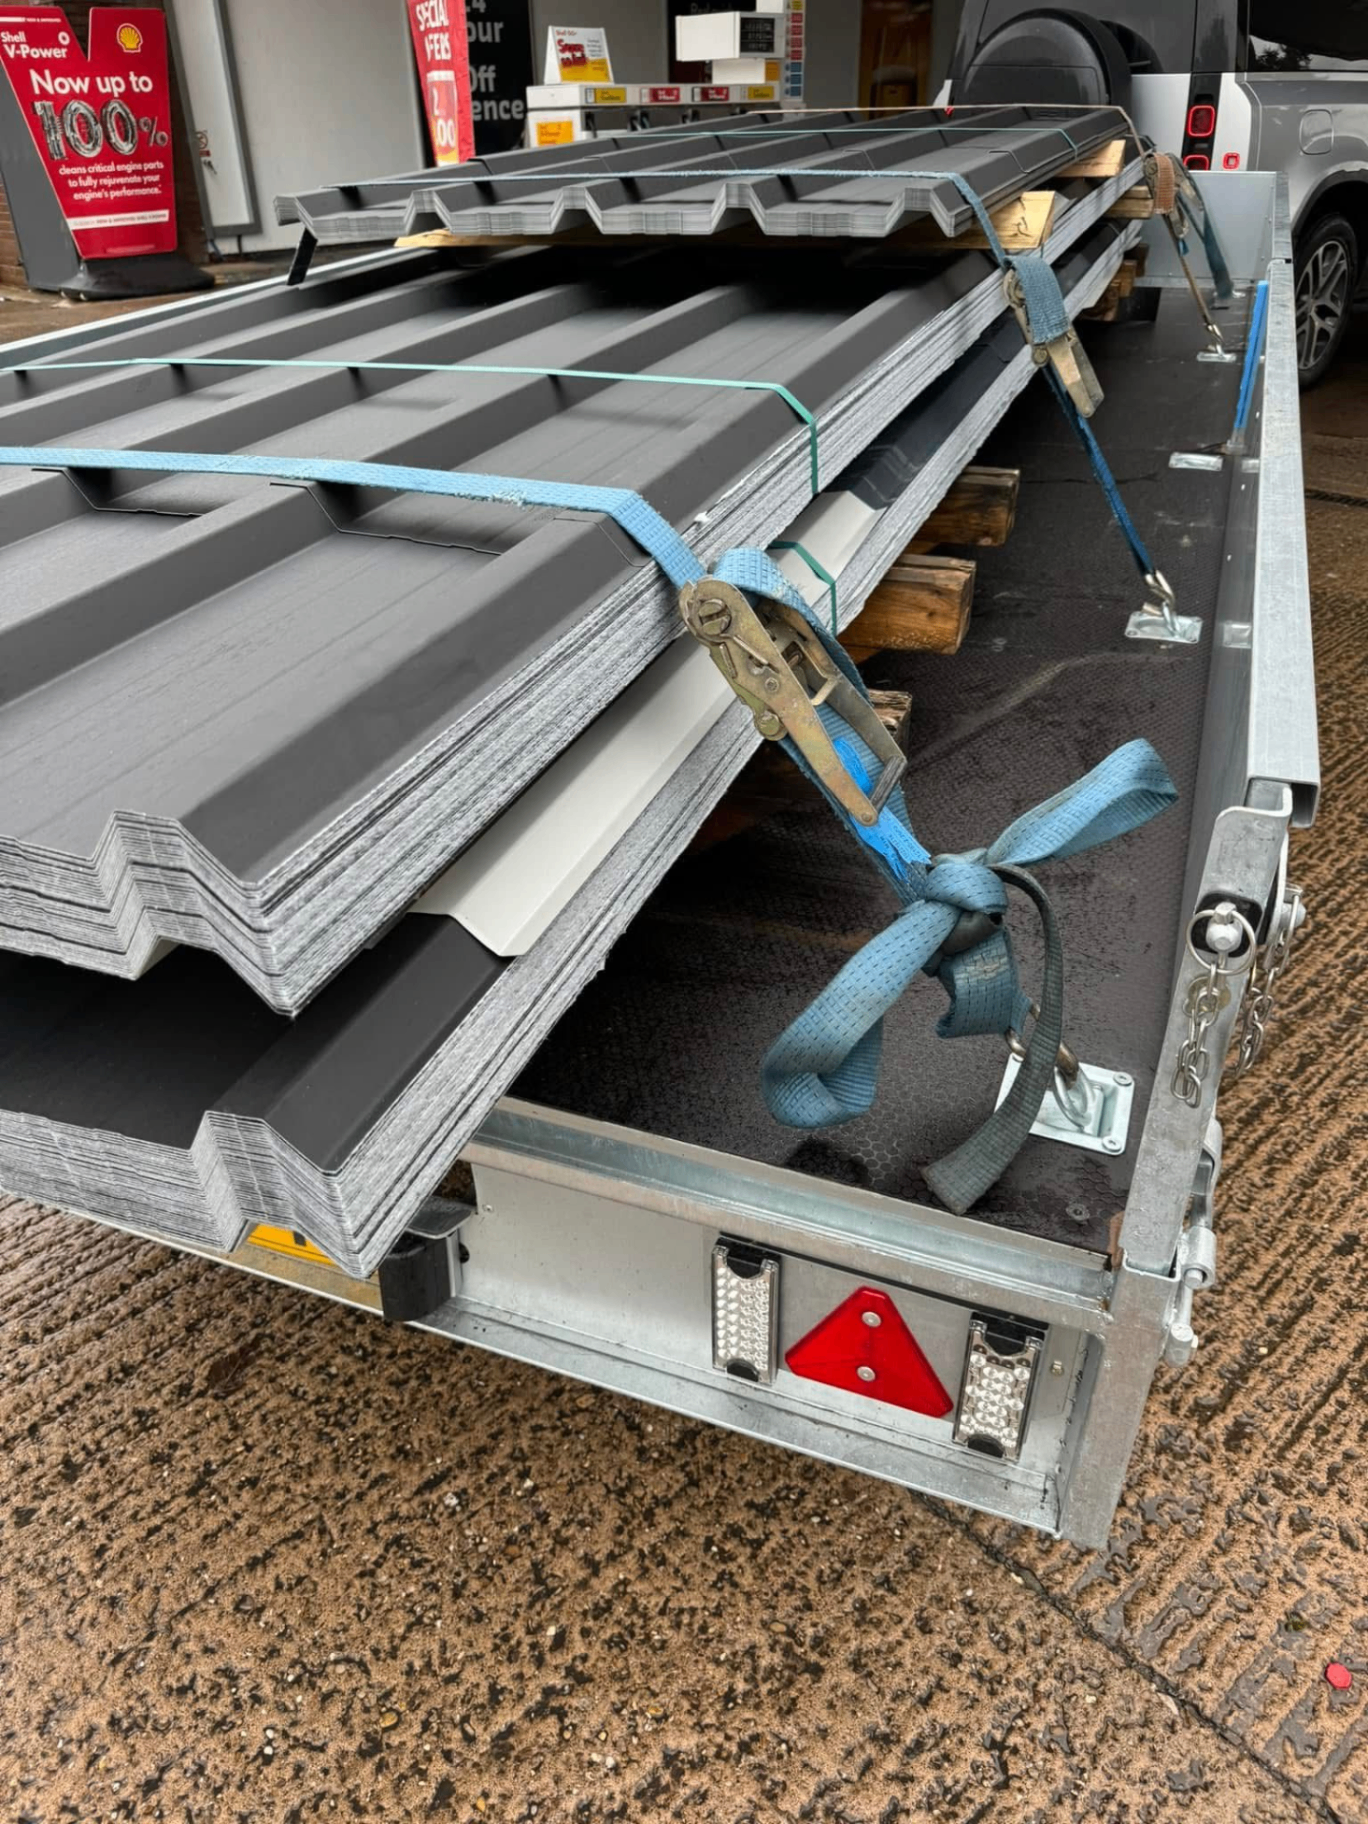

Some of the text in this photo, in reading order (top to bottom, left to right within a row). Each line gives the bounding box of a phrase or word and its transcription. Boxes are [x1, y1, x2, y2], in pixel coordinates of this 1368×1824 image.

[1, 31, 26, 43] Shell
[3, 44, 68, 59] V-Power
[29, 69, 153, 98] Now up to
[33, 99, 168, 160] 100%
[59, 160, 164, 175] cleans critical engine parts
[68, 175, 160, 188] to fully rejuvenate your
[73, 189, 108, 202] engine's
